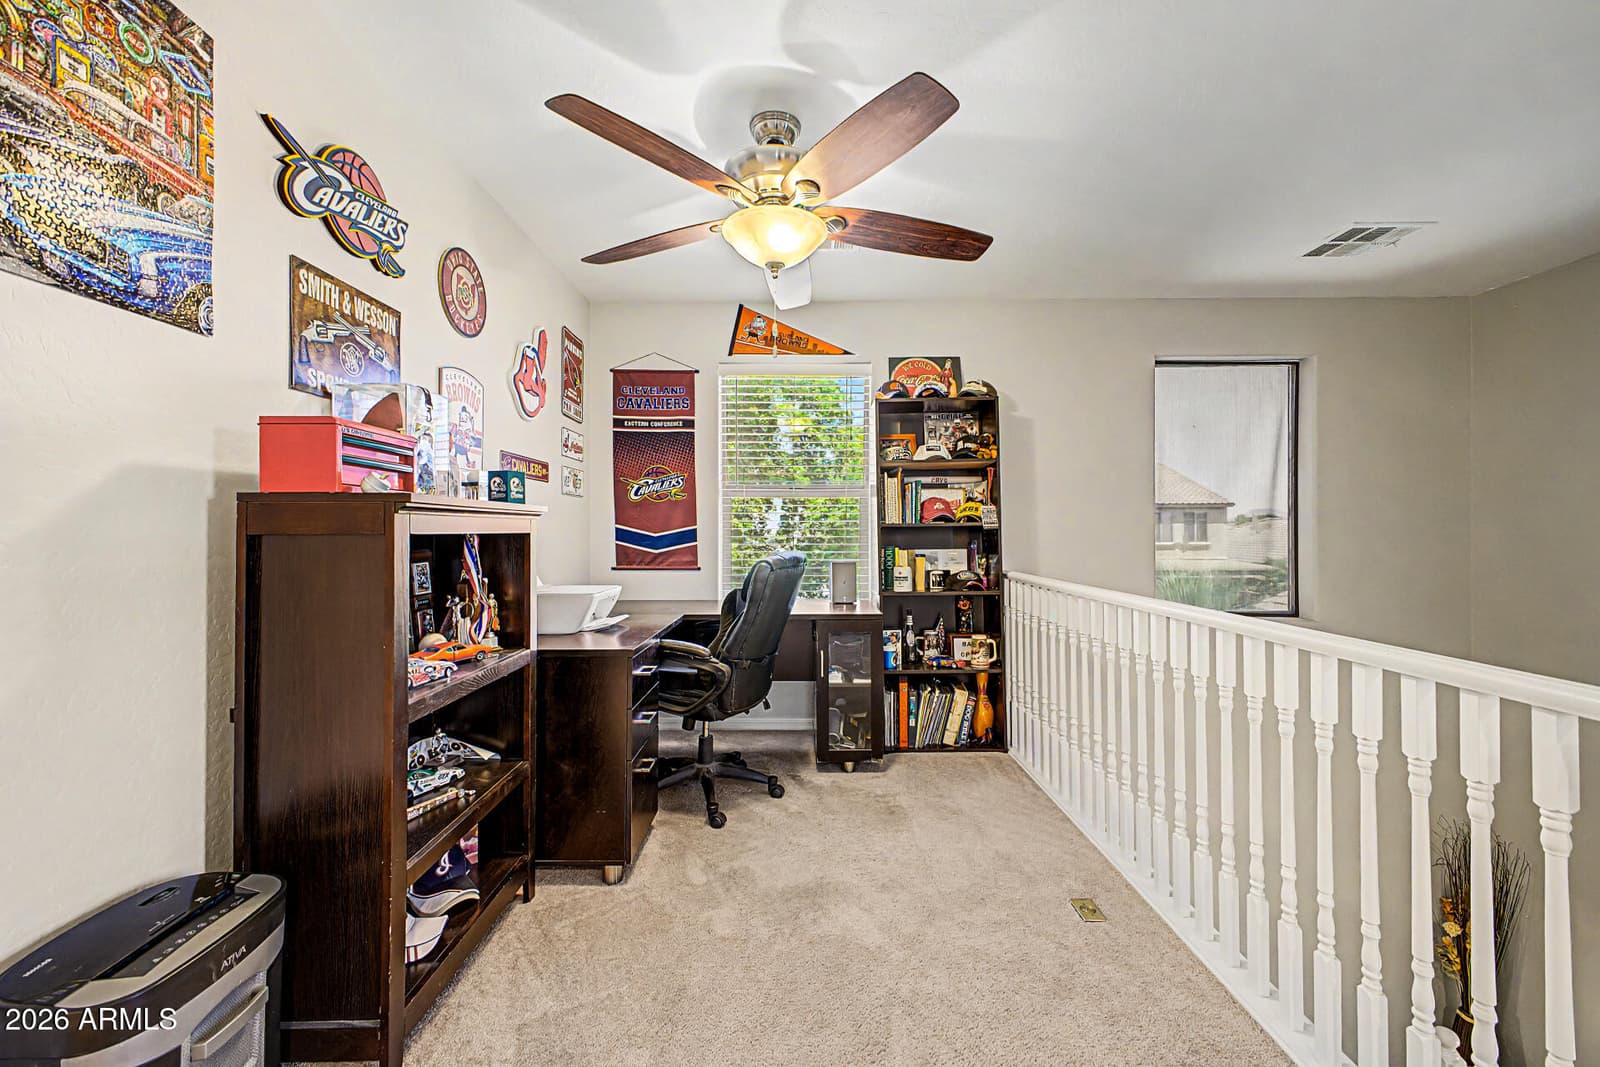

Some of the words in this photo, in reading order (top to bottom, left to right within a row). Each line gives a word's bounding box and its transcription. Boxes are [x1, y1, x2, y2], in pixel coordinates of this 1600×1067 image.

[292, 161, 406, 246] CAVALIERS
[354, 191, 398, 218] CLEVELAND
[299, 268, 340, 310] SMITH
[343, 291, 352, 316] &
[353, 295, 397, 337] WESSON
[445, 373, 482, 395] CLEVELAND
[621, 386, 686, 395] CLEVELAND
[445, 382, 482, 414] BROWNS
[617, 397, 690, 410] CAVALIERS
[629, 475, 685, 500] CAVALIERS
[220, 944, 247, 972] ATIVA
